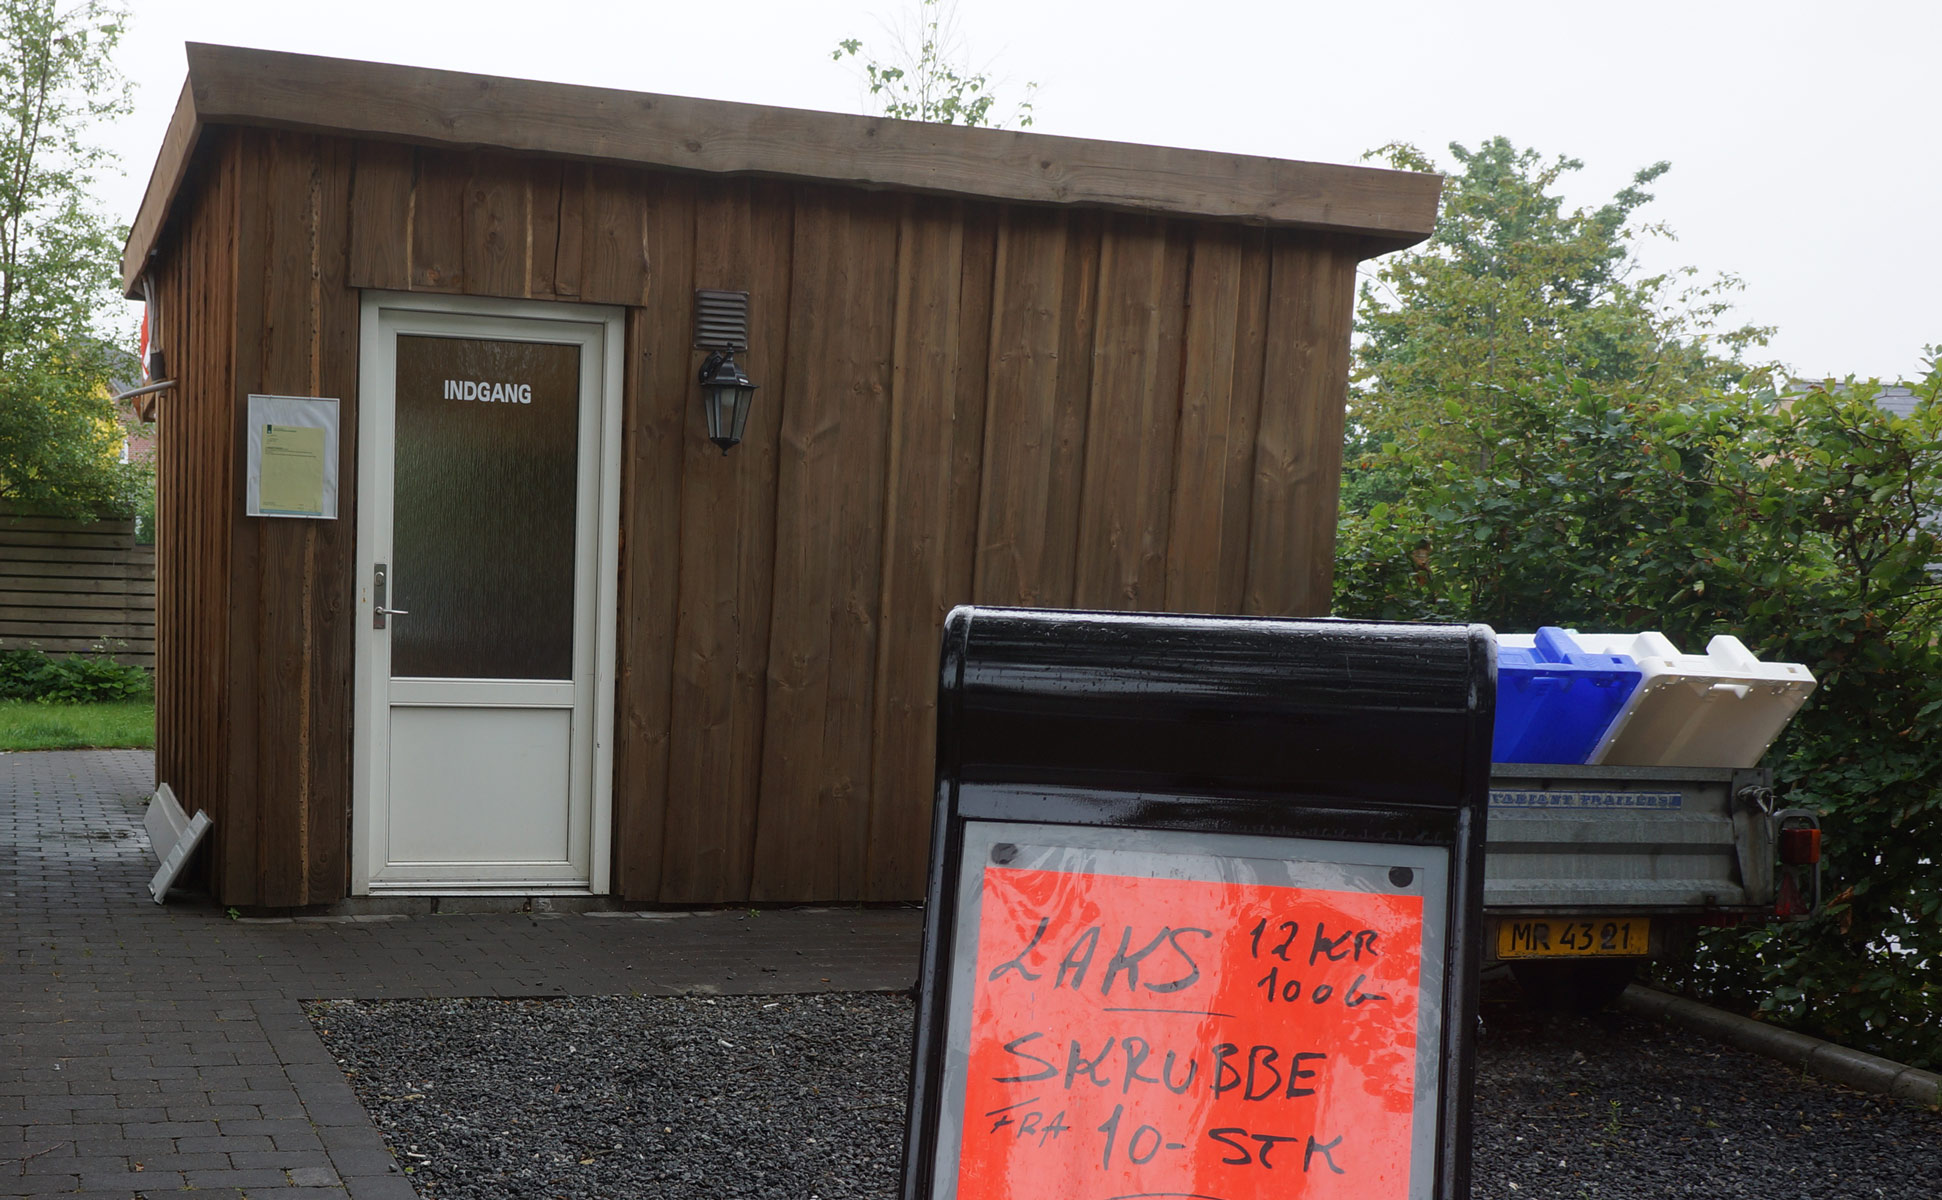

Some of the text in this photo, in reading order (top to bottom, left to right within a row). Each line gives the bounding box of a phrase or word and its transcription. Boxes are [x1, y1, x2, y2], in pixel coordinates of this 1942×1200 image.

[444, 380, 532, 404] INDGANG
[988, 916, 1213, 997] LAKS
[1250, 918, 1379, 966] 12 KR
[1511, 922, 1550, 951] MR
[992, 1032, 1328, 1101] SKRUBBE
[985, 1097, 1070, 1147] FRA
[1207, 1127, 1345, 1175] STK
